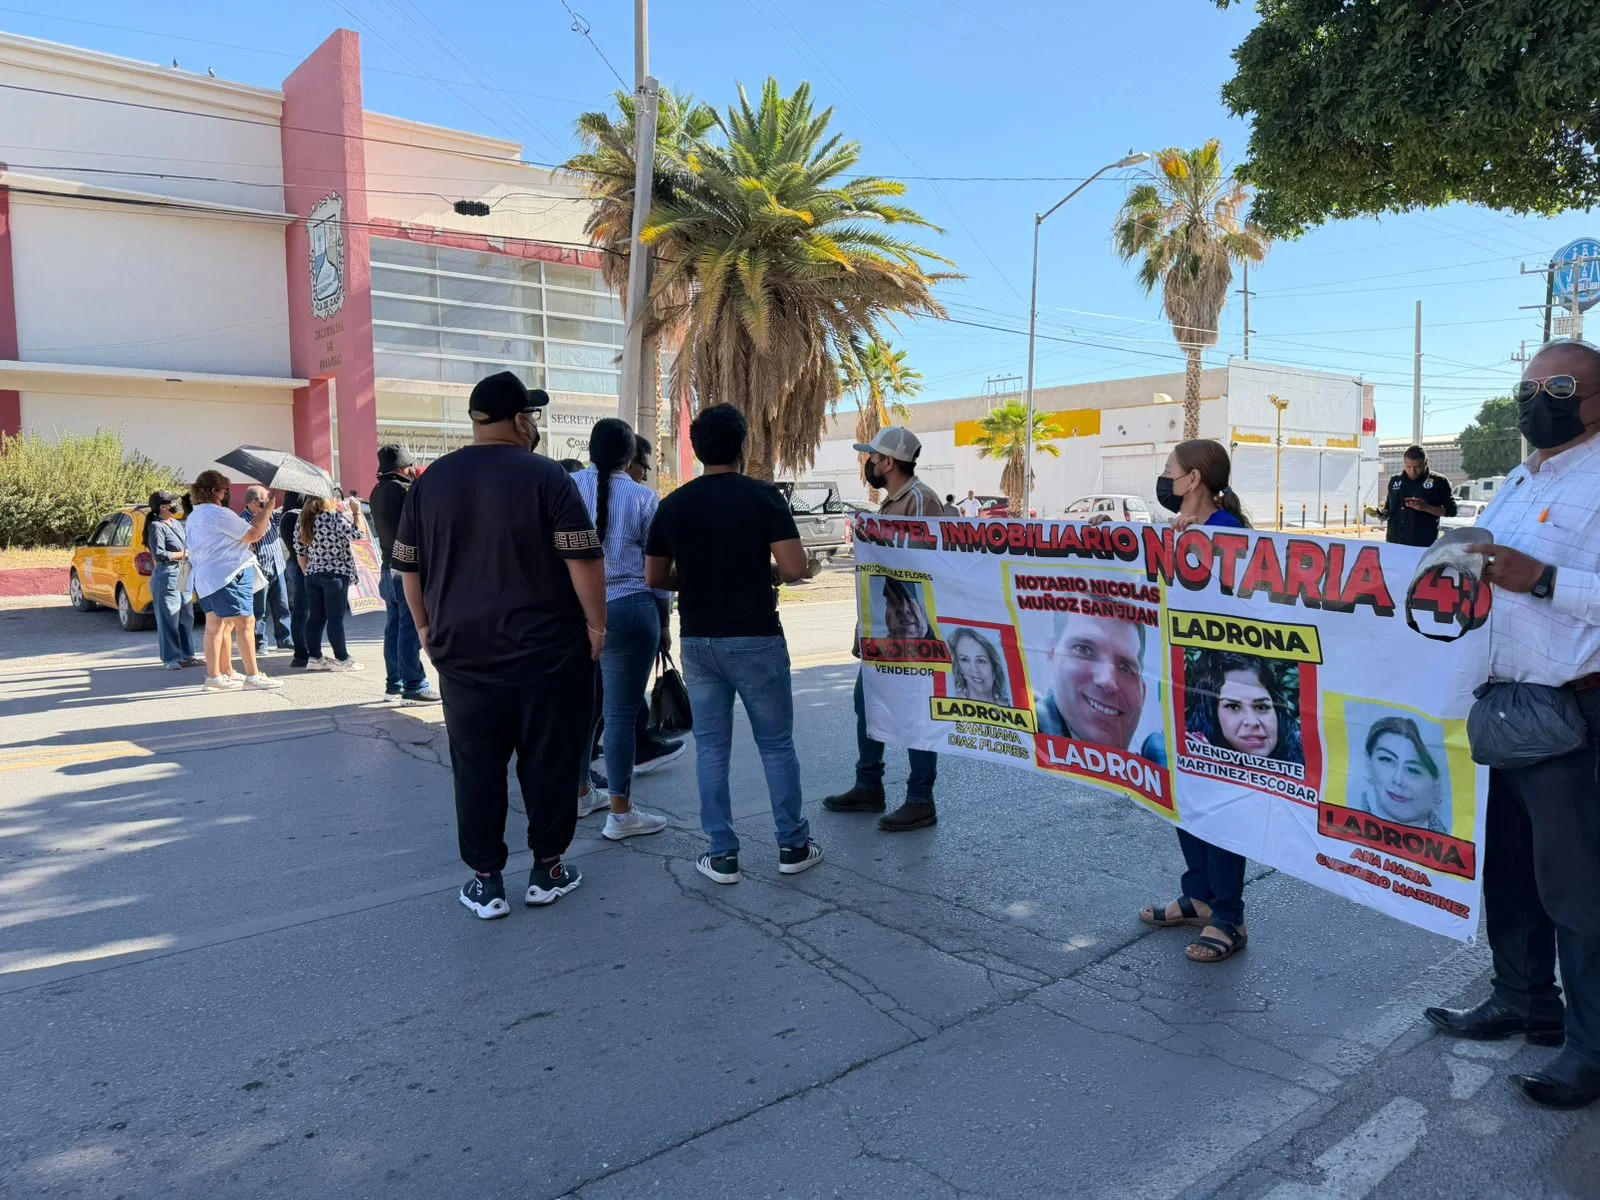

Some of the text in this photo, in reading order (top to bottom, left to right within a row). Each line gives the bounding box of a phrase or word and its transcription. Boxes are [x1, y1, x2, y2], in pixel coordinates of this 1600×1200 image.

[551, 413, 606, 426] SECRETA
[939, 521, 1139, 562] INMOBILIARIO
[1142, 526, 1396, 617] NOTARIA
[1015, 574, 1161, 604] NOTARIO NICOLAS
[1016, 593, 1080, 613] MUÑOZ
[866, 642, 947, 659] LADRON
[1172, 617, 1310, 654] LADRONA
[875, 664, 934, 677] VENDEDOR
[936, 701, 1028, 728] LADRONA
[947, 732, 1029, 760] DIAZ FLORES
[955, 721, 1021, 744] SANJUANA
[1047, 740, 1162, 797] LADRON
[1187, 741, 1304, 778] WENDY LIZETTE
[1177, 756, 1316, 802] MARTINEZ ESCOBAR
[1325, 810, 1467, 870] LADRONA
[1351, 848, 1432, 887] ANA MARIA
[1392, 879, 1470, 920] MARTINEZ
